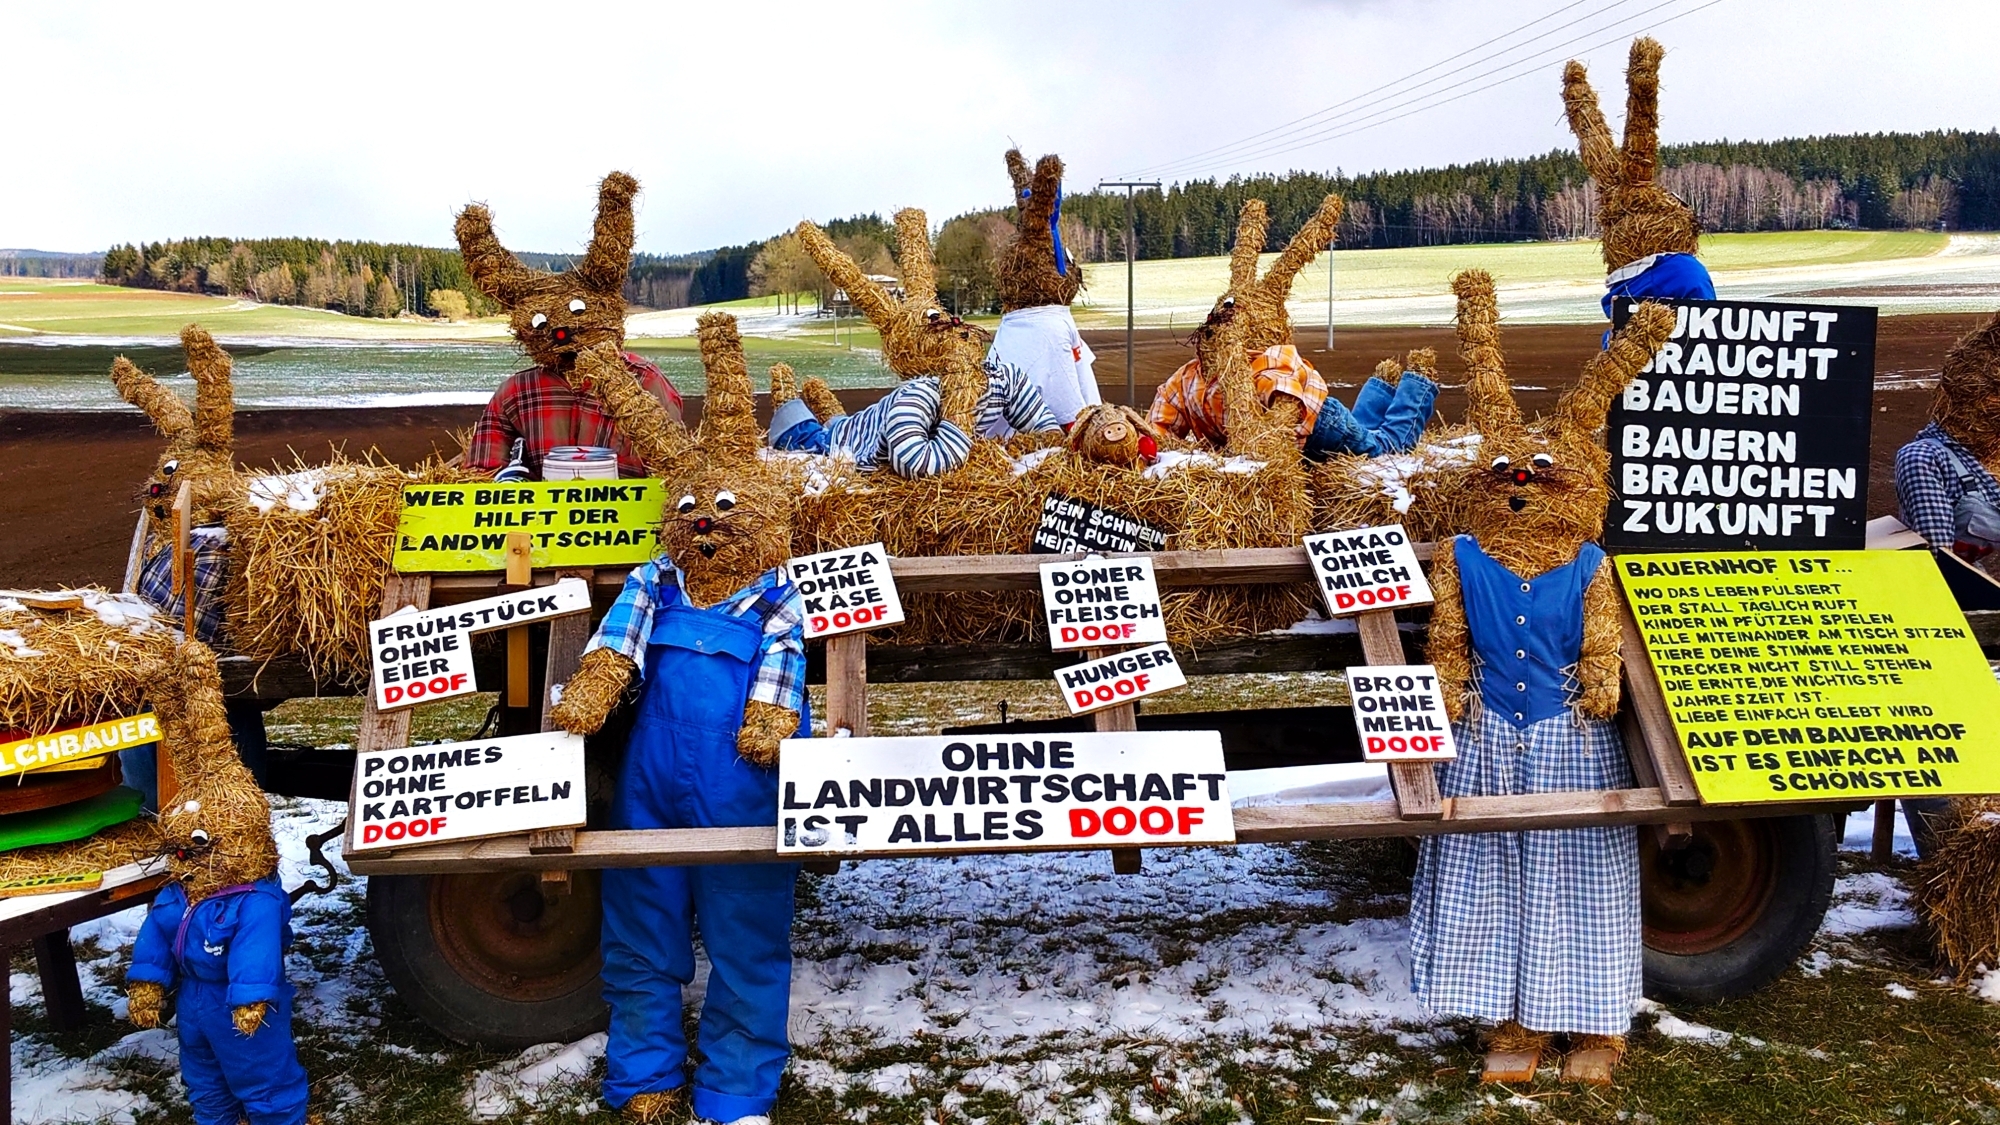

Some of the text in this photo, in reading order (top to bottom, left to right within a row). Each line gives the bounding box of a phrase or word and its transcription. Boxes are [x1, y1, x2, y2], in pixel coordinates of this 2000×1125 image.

[1628, 304, 1838, 343] UKUNFT
[1641, 342, 1838, 380] RAUCHT
[1622, 379, 1800, 416] BAUERN
[1622, 424, 1797, 463] BAUERN
[1622, 462, 1856, 499] BRAUCHEN
[404, 485, 648, 507] WER BIER TRINKT
[474, 508, 619, 528] HILFT DER
[1045, 497, 1166, 545] KEIN SCHWEIN
[1623, 500, 1835, 537] ZUKUNFT
[401, 529, 661, 552] LANDWTSCHAFT
[1041, 513, 1136, 552] WILL PUTIN
[1309, 531, 1404, 556] KAKAO
[793, 551, 879, 579] PIZZA
[1322, 549, 1395, 572] OHNE
[1626, 558, 1778, 578] BAUERNHOF
[799, 569, 874, 595] OHNE
[1052, 564, 1145, 586] DÖNER
[1324, 566, 1411, 590] MILCH
[805, 587, 883, 614] KÄSE
[1055, 586, 1130, 605] OHNE
[1334, 585, 1412, 609] DOOF
[1633, 583, 1842, 600] WO DAS LEBEN PULSIERT
[811, 605, 888, 632] DOOF
[1050, 603, 1159, 624] FLEISCH
[1637, 598, 1858, 615] DER STALL TÄGLICH RUFT
[377, 594, 559, 645] FRÜHSTÜCK
[1643, 612, 1894, 630] KINDER IN PFÜTZEN SPIELEN
[1061, 623, 1137, 643] DOOF
[1648, 627, 1966, 646] ALLE MITEINANDER AM TISCH SITZEN
[380, 634, 459, 664] OHNE
[1651, 643, 1909, 661] TIERE DEINE STIMME KENNEN
[383, 658, 449, 684] EIER
[1063, 650, 1174, 689] HUNGER
[1658, 658, 1932, 677] TRECKER NICHT STILL STEHEN
[384, 673, 467, 704] DOOF
[1074, 674, 1151, 708] DOOF
[1353, 675, 1435, 692] BROT
[1665, 678, 1694, 693] DIE
[1761, 676, 1788, 688] DIE
[1791, 674, 1903, 687] WICHTIGSTE
[1358, 695, 1436, 712] OHNE
[1672, 691, 1829, 707] JAHRESZEIT IST.
[1362, 715, 1443, 732] MEHL
[1676, 705, 1934, 724] LIEBE EINFACH GELEBT WIRD
[1367, 735, 1445, 754] DOOF
[1687, 722, 1967, 749] AUF DEM BAUERNHOF
[364, 746, 503, 777] POMMES
[942, 741, 1075, 772] OHNE
[1691, 746, 1959, 773] IST ES EINFACH AM
[363, 773, 446, 798] OHNE
[783, 772, 1226, 810] LANDWIRTSCHAFT
[1768, 769, 1942, 792] SCHÖNSTEN
[363, 781, 571, 821] KARTOFFELN
[363, 817, 447, 844] DOOF
[784, 805, 1205, 847] IST ALLES DOOF
